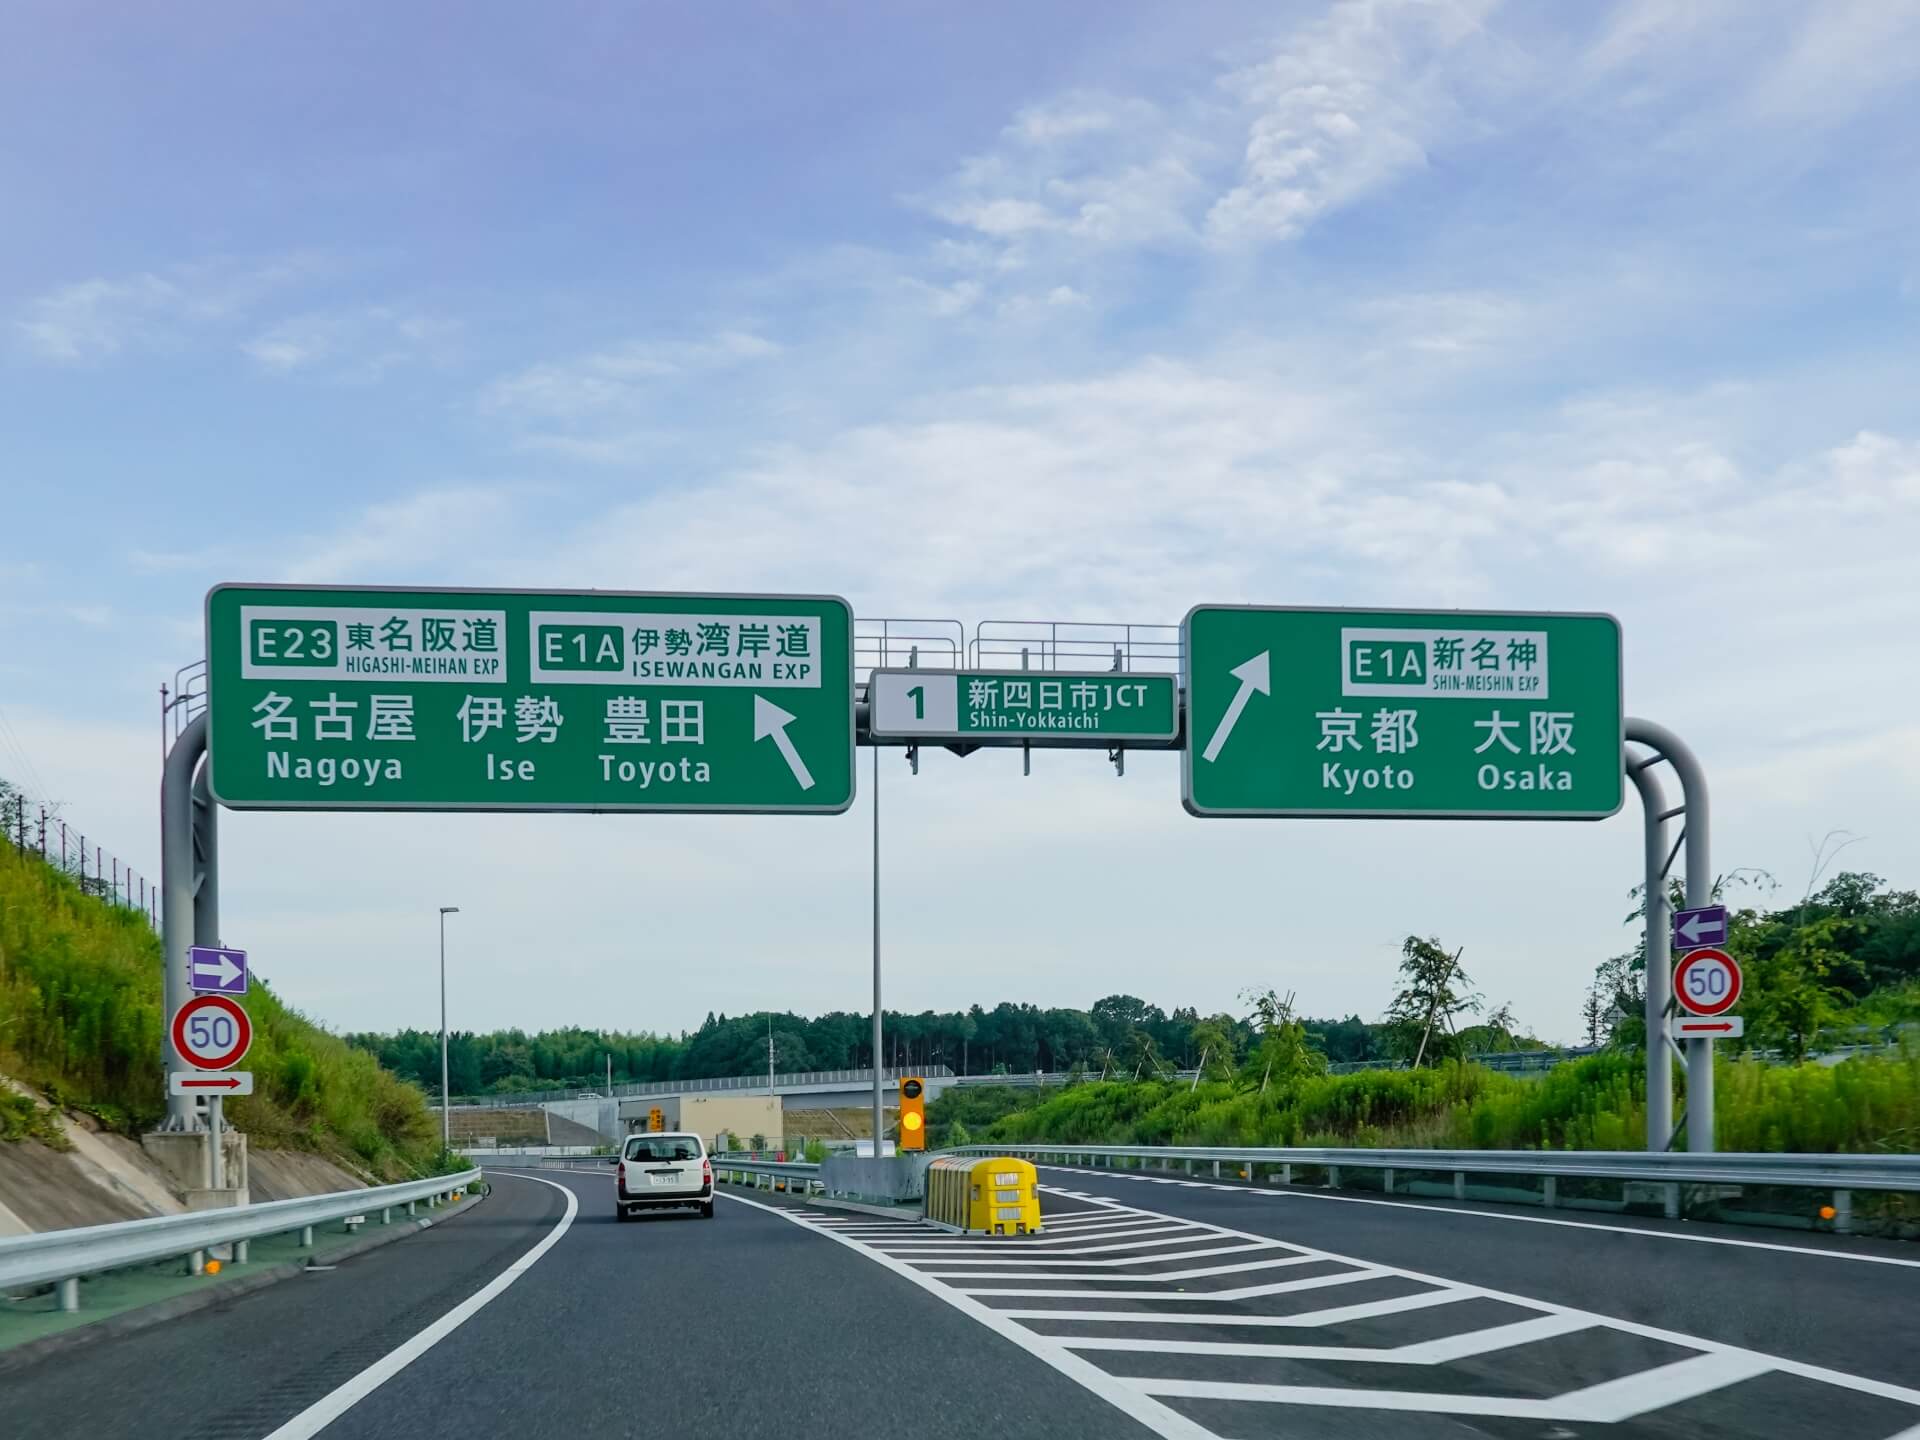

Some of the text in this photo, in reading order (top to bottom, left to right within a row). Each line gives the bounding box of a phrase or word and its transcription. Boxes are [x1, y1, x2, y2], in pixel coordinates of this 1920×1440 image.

[257, 627, 332, 659] E23
[345, 616, 499, 653] 東名阪道
[544, 632, 619, 664] E1A
[631, 622, 811, 659] 伊勢湾岸道
[346, 656, 500, 675] HIGASHI-MEIHAN EXP
[1355, 648, 1422, 678] E1A
[1433, 636, 1538, 672] 新名神
[632, 661, 811, 680] ISEWANGAN EXP
[1432, 675, 1540, 692] SHIN-MEISHIN EXP
[905, 686, 925, 720] 1
[968, 679, 1148, 711] 新四日市JCT
[250, 690, 705, 745] 名古屋 伊勢 豊田
[970, 711, 1099, 729] Shin-Yokkaichi
[1314, 706, 1577, 756] 京都 大阪
[267, 751, 711, 789] Nagoya Ise Toyota
[1322, 762, 1573, 796] Kyoto Osaka
[1689, 968, 1726, 996] 50
[190, 1016, 233, 1049] 50
